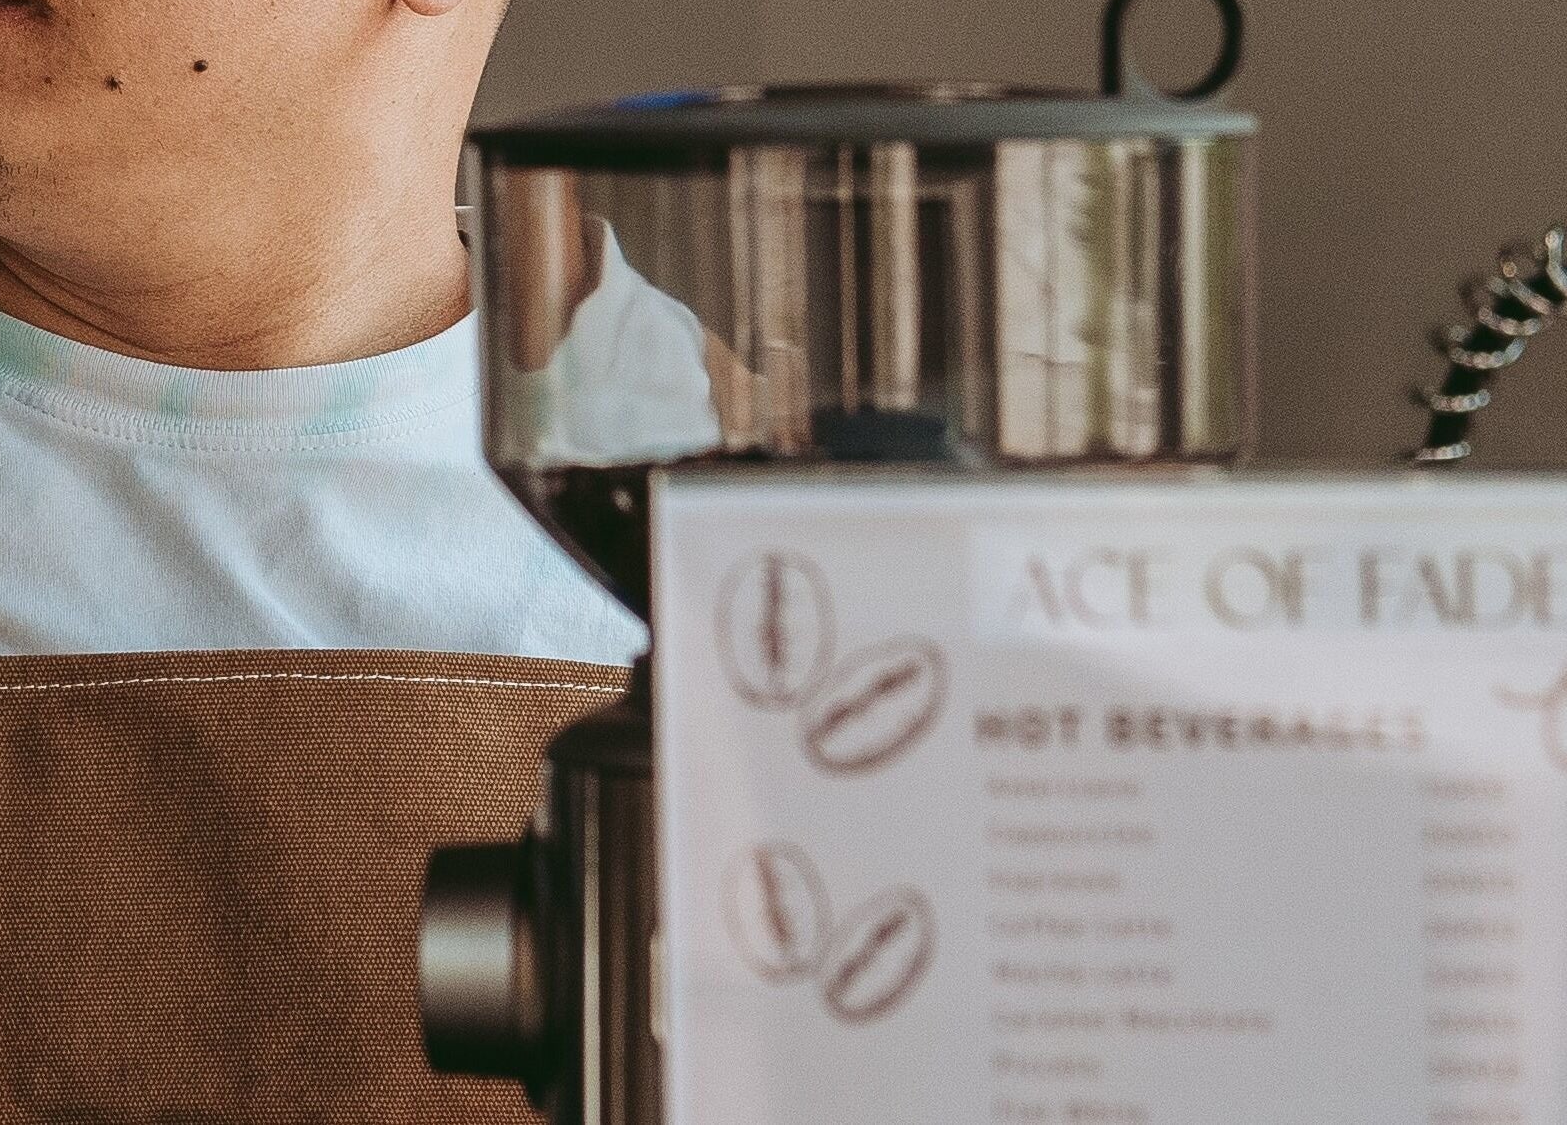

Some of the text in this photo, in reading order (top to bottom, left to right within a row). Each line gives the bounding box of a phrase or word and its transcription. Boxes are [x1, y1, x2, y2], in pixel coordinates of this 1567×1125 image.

[1005, 546, 1178, 626] ACE
[1201, 543, 1331, 629] OF
[974, 705, 1428, 749] HOT BEVERAGES
